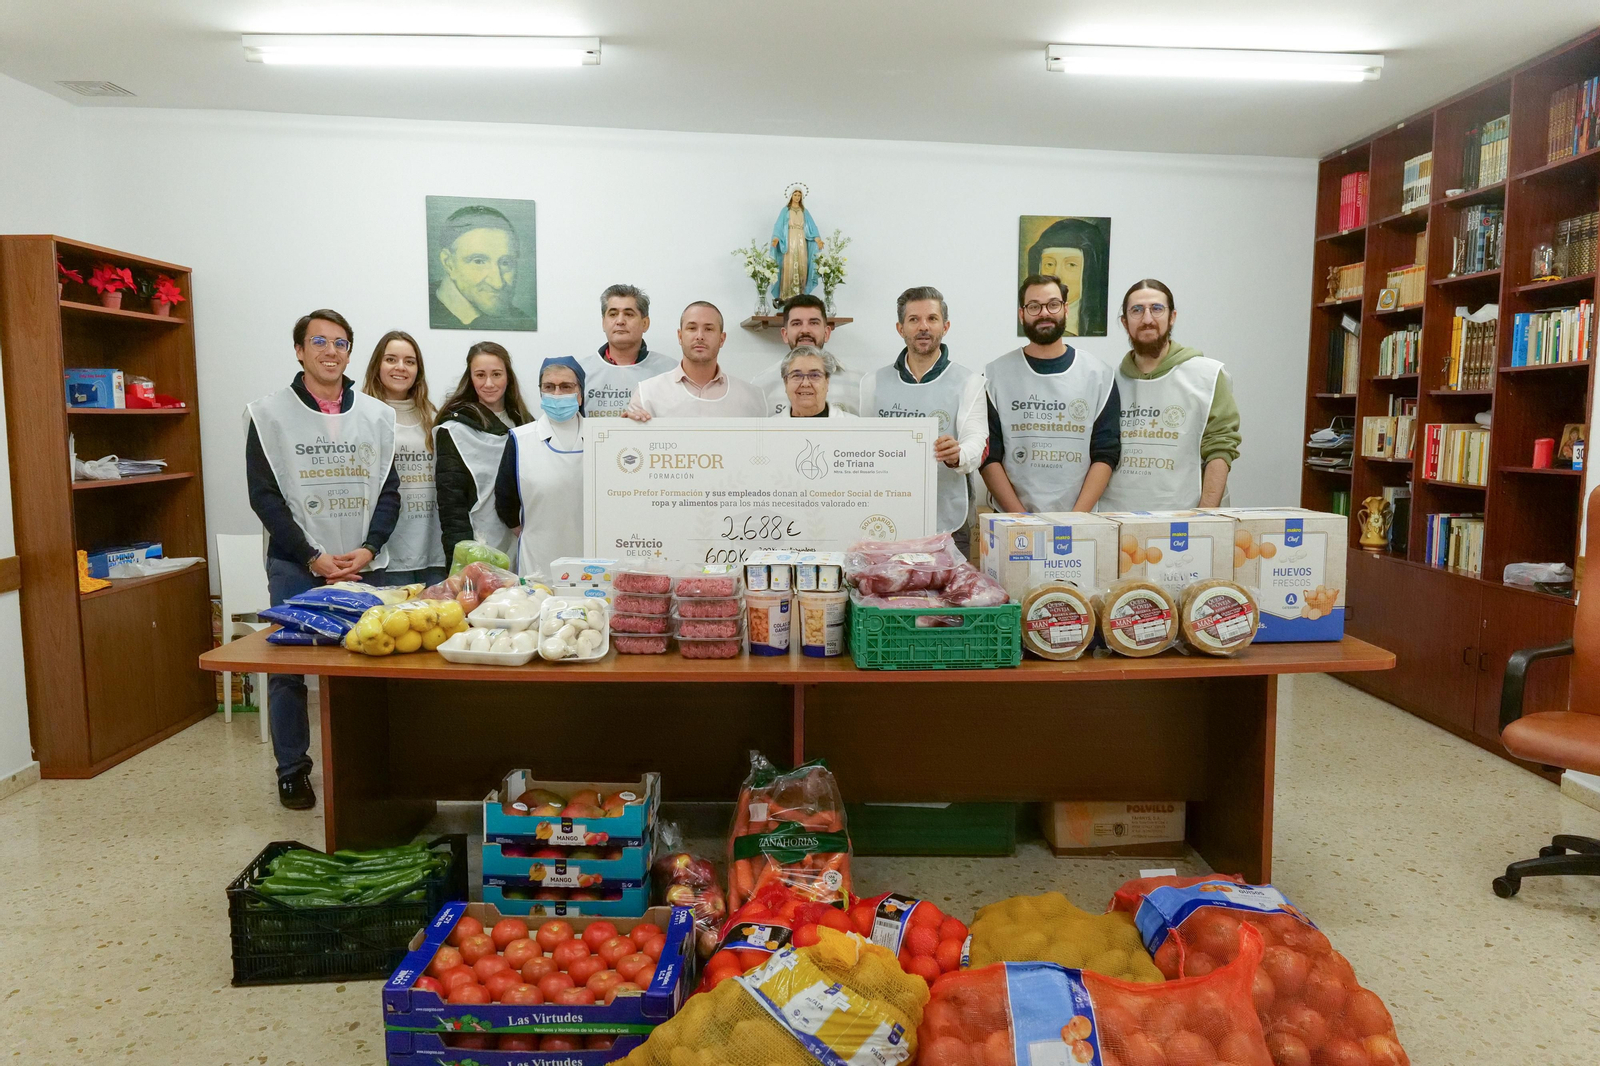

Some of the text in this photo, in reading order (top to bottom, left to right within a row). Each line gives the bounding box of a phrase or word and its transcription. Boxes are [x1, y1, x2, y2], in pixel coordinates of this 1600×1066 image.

[1011, 400, 1066, 411] Servicio
[588, 408, 627, 418] necesi
[1120, 406, 1160, 418] ericio
[1011, 421, 1085, 433] necesitados
[1120, 428, 1179, 440] cesitados
[295, 442, 356, 455] Servicio
[649, 442, 677, 450] grupo
[312, 456, 325, 465] DE
[328, 456, 346, 464] LOS
[394, 451, 434, 462] ervicio
[649, 454, 724, 469] PREFOR
[1031, 450, 1082, 463] PREFOR
[1122, 457, 1175, 470] PREFOR
[400, 473, 434, 482] cesita
[328, 488, 349, 497] grupo
[607, 489, 632, 498] Grupo
[660, 489, 703, 497] Formación
[728, 489, 771, 499] empleados
[407, 500, 438, 512] PREFO
[862, 516, 894, 534] SOLIDARIDAD
[616, 538, 663, 548] Servicio
[1018, 538, 1026, 547] XL
[1044, 560, 1081, 568] HUEVOS
[1273, 568, 1312, 576] HUEVOS
[1273, 579, 1311, 587] FRESCOS
[1126, 805, 1174, 813] POLVILLO
[759, 837, 818, 847] ZANAHORIAS
[508, 1013, 583, 1026] Las Virtudes
[870, 1047, 886, 1066] PATATA
